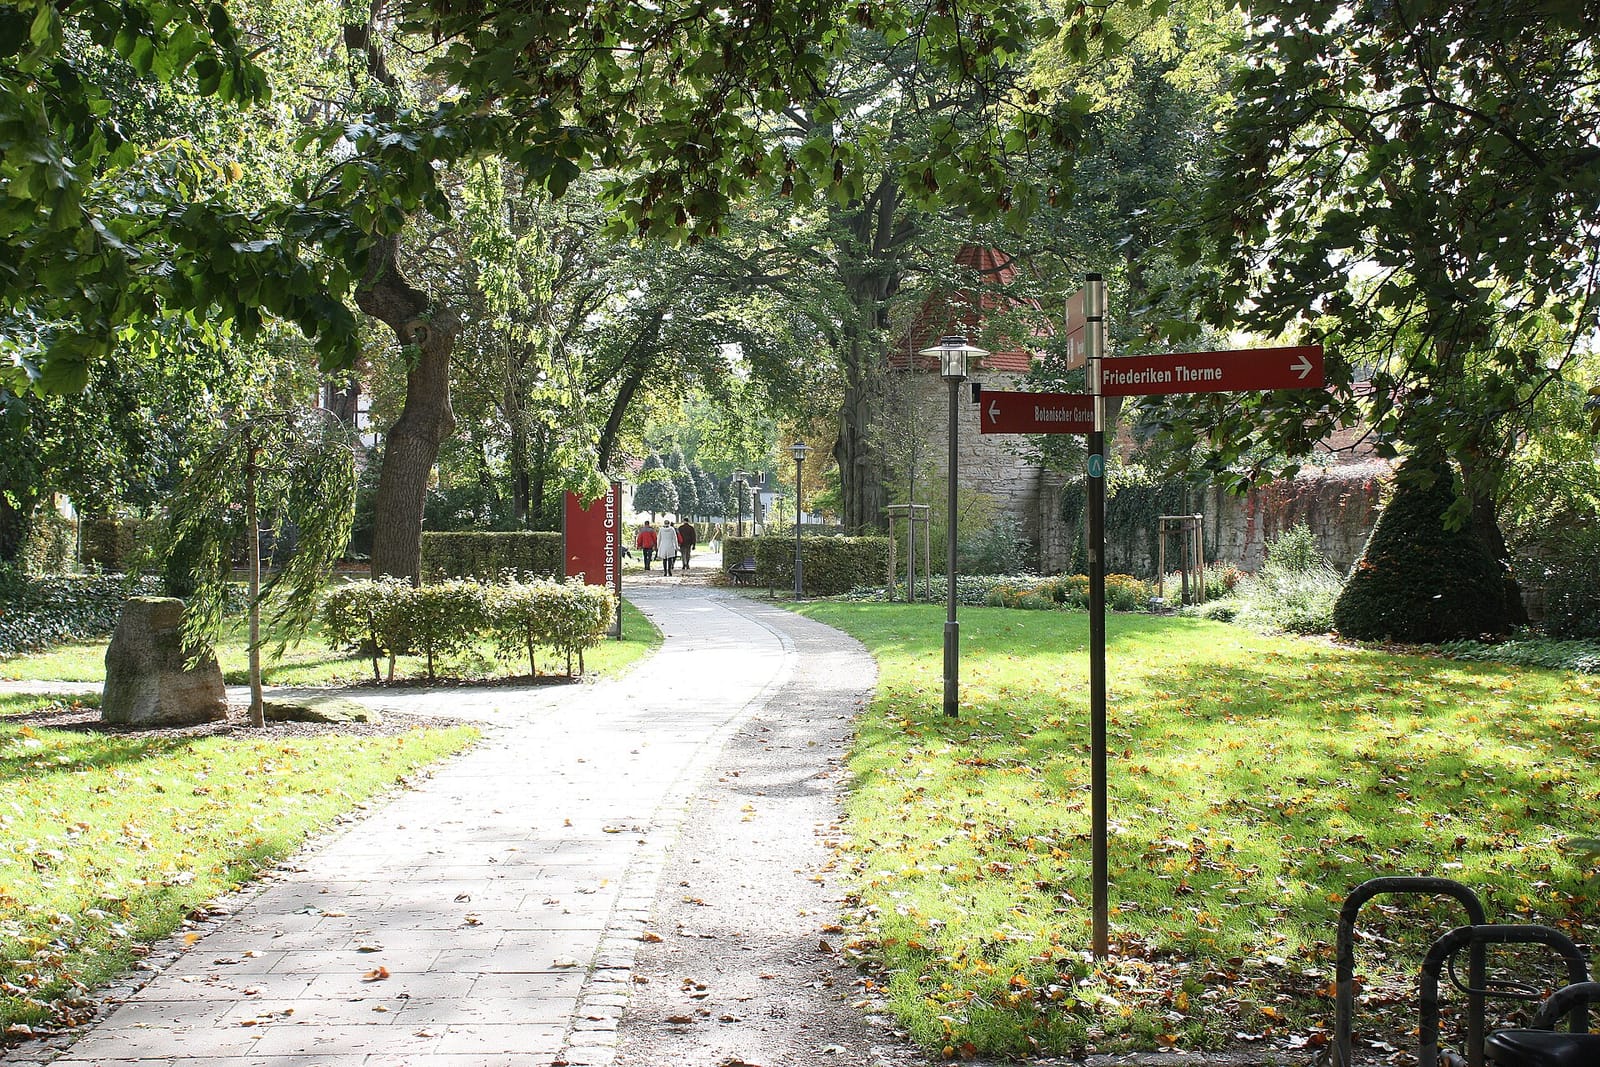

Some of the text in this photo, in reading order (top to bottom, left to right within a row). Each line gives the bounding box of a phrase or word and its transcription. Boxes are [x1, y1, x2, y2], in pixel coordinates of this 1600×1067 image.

[1103, 366, 1223, 385] Friederiken Therme
[1034, 405, 1094, 422] Botanischer Garten
[603, 489, 614, 583] anischer Garten
